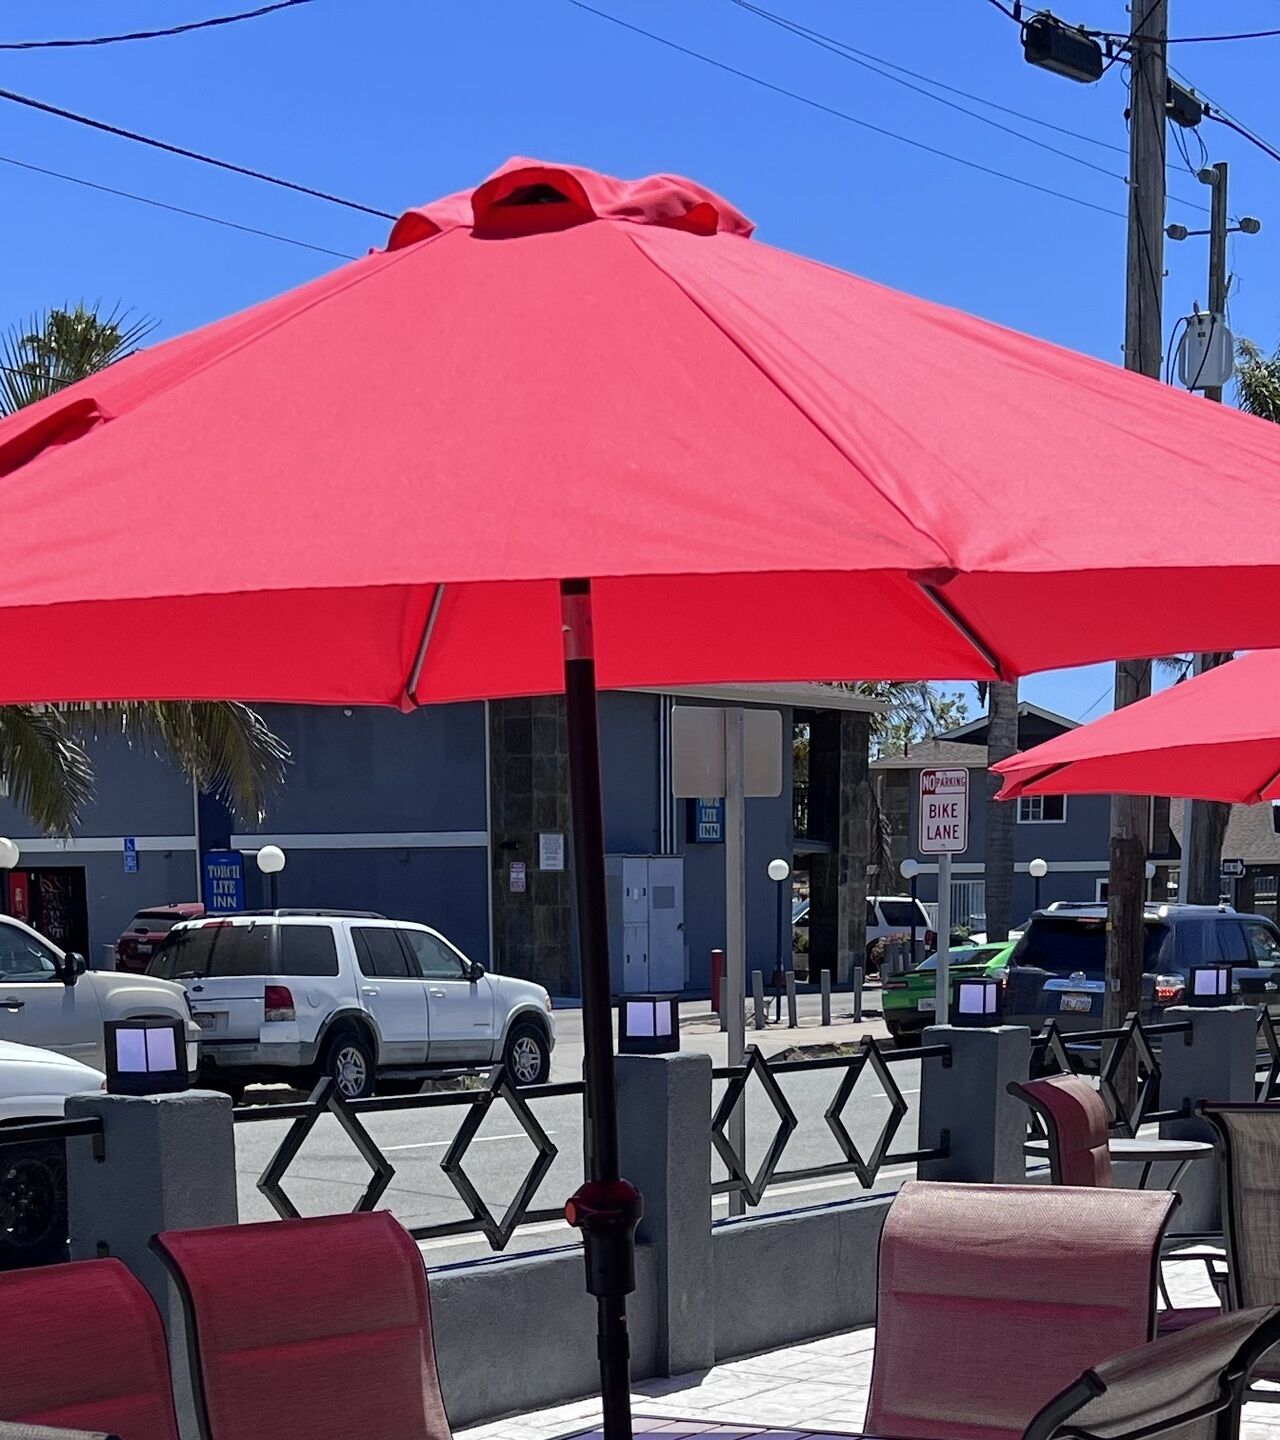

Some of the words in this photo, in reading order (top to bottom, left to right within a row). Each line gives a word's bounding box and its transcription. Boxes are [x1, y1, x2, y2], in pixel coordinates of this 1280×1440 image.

[922, 775, 935, 791] NO
[936, 776, 966, 788] PARKING
[929, 803, 958, 818] BIKE
[700, 823, 720, 838] INN
[927, 825, 959, 840] LANE
[208, 865, 240, 878] TORCH
[213, 880, 236, 893] LITE
[213, 896, 236, 907] INN
